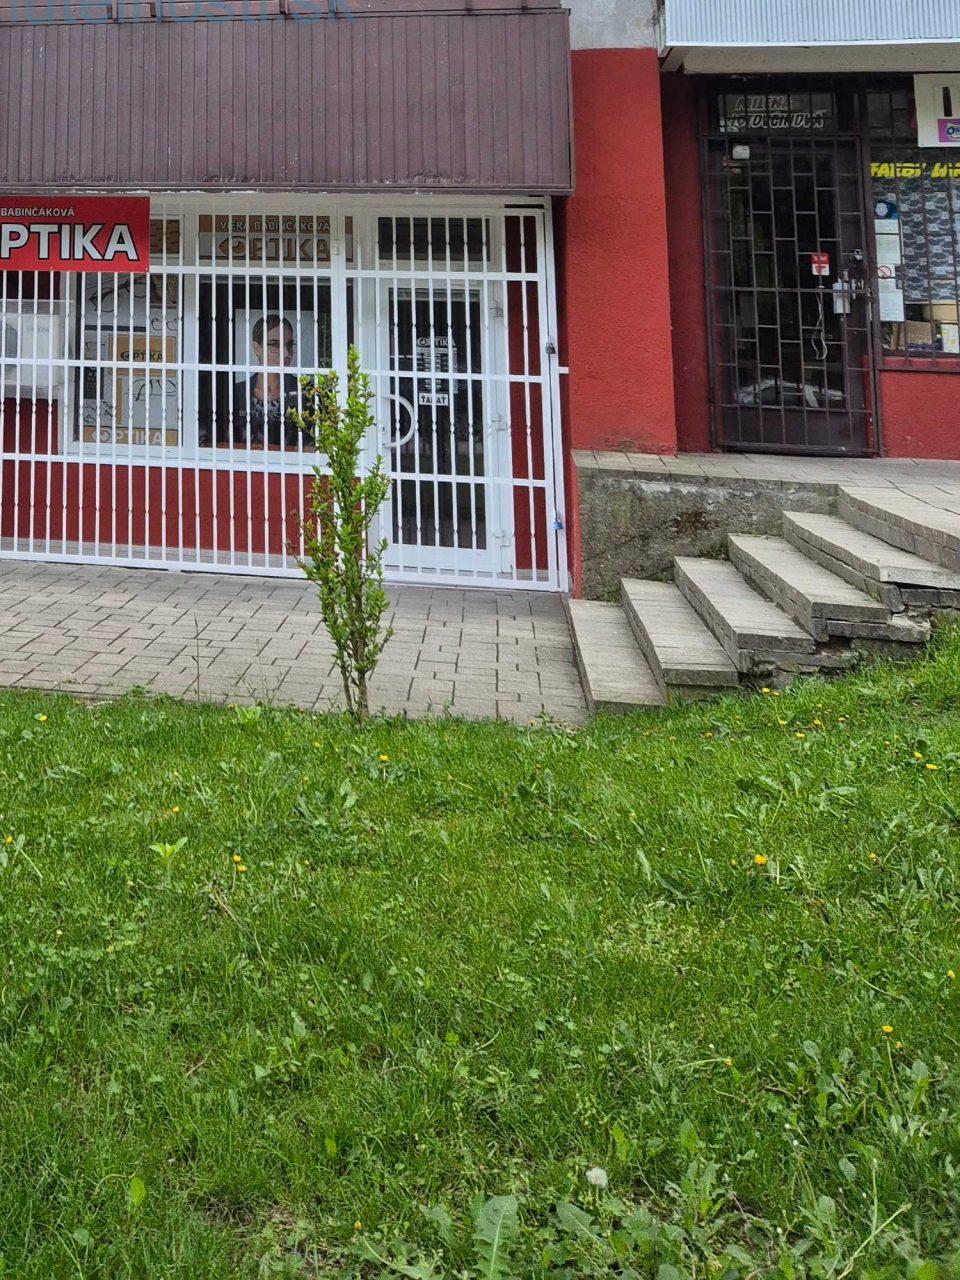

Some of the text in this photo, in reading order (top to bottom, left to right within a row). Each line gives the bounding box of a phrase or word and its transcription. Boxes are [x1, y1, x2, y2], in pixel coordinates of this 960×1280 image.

[0, 205, 75, 217] BABINČÁKOVÁ
[220, 221, 250, 230] VERA
[120, 350, 163, 362] OPTKA
[420, 394, 447, 405] ŤAAŤ
